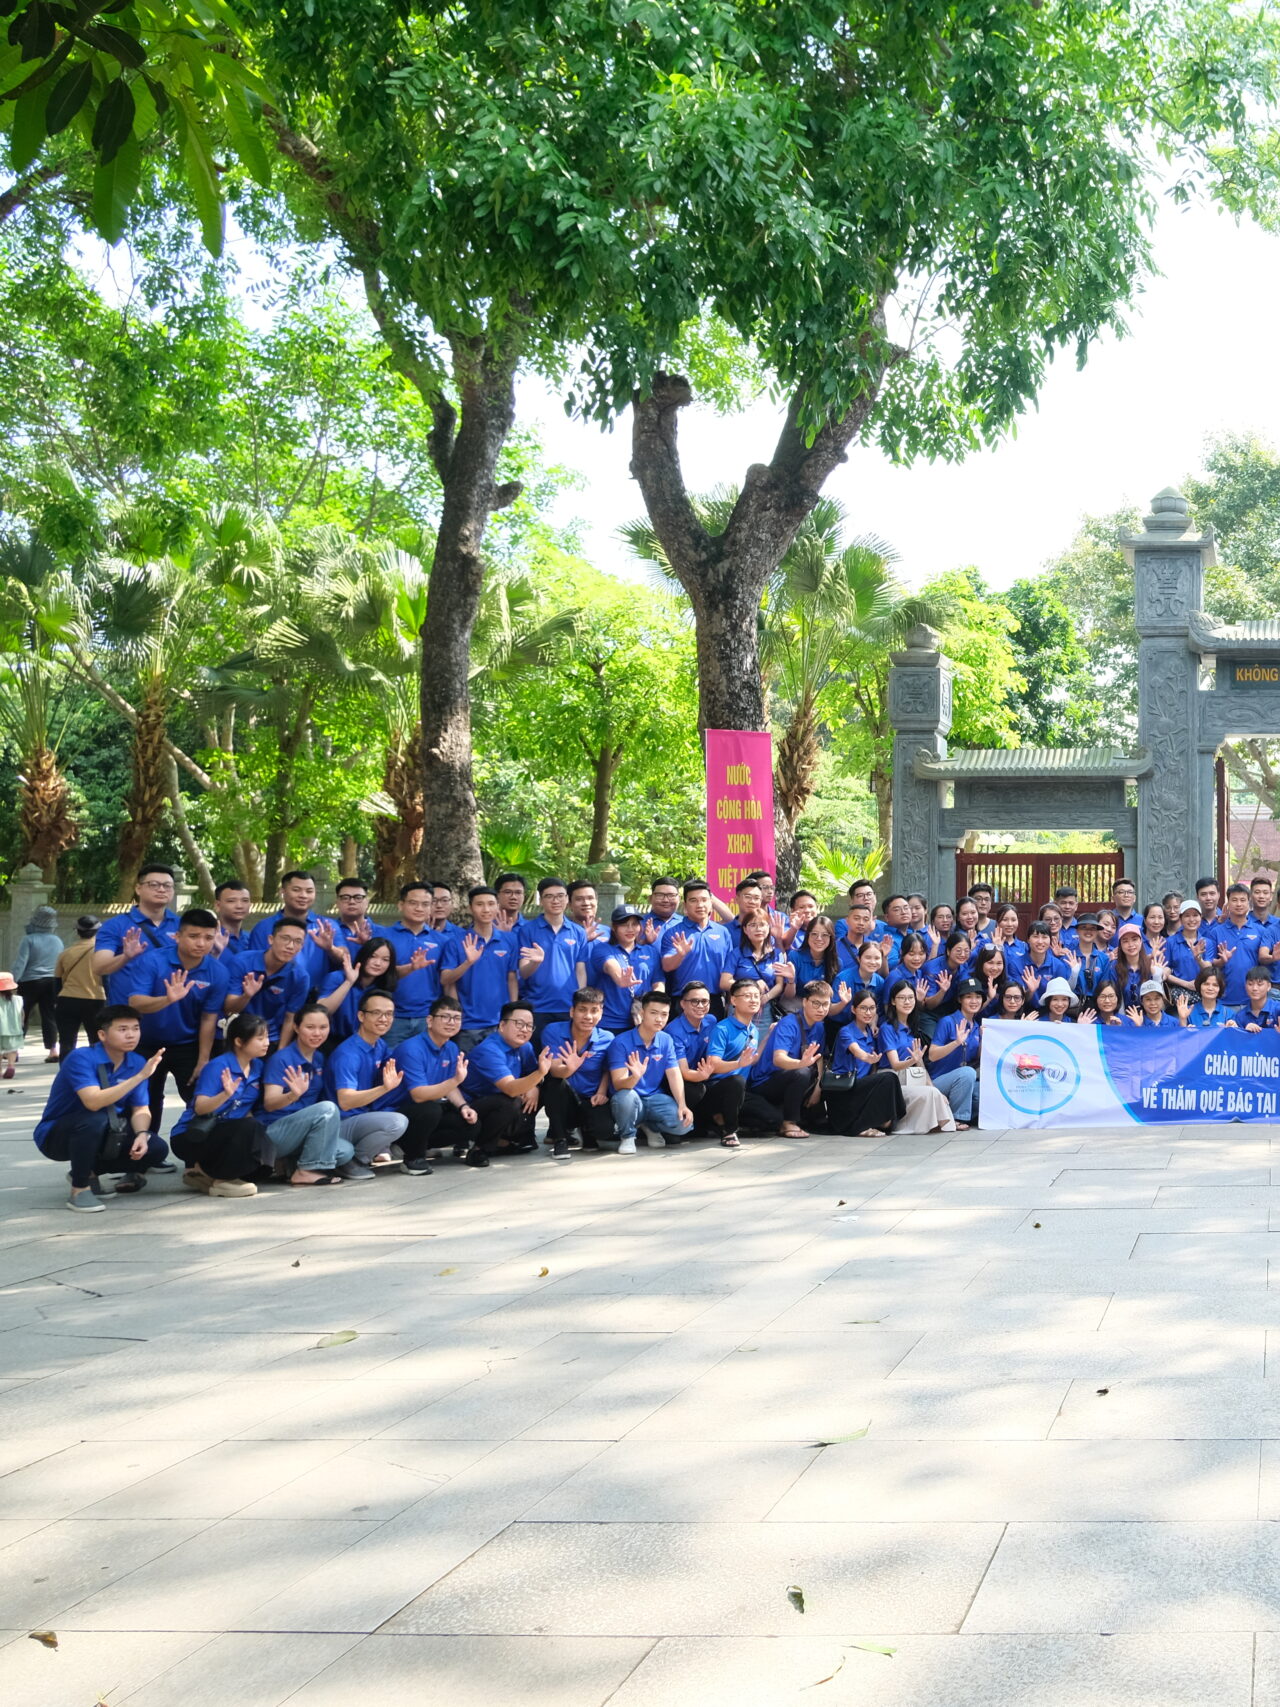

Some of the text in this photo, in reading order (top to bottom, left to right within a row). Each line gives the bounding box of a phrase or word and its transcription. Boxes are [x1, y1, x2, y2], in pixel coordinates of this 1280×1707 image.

[1236, 664, 1278, 681] KHÔNG
[726, 761, 751, 786] NƯỚC
[716, 795, 742, 824] CỘNG
[727, 834, 753, 854] XHCN
[718, 864, 739, 892] VIỆT
[1204, 1050, 1237, 1076] CHÀO
[1241, 1052, 1279, 1078] MỪNG
[1142, 1081, 1158, 1109] VỀ
[1161, 1084, 1196, 1110] THĂM
[1200, 1086, 1224, 1113] QUÊ
[1226, 1088, 1252, 1114] BÁC
[1256, 1092, 1276, 1118] TẠI
